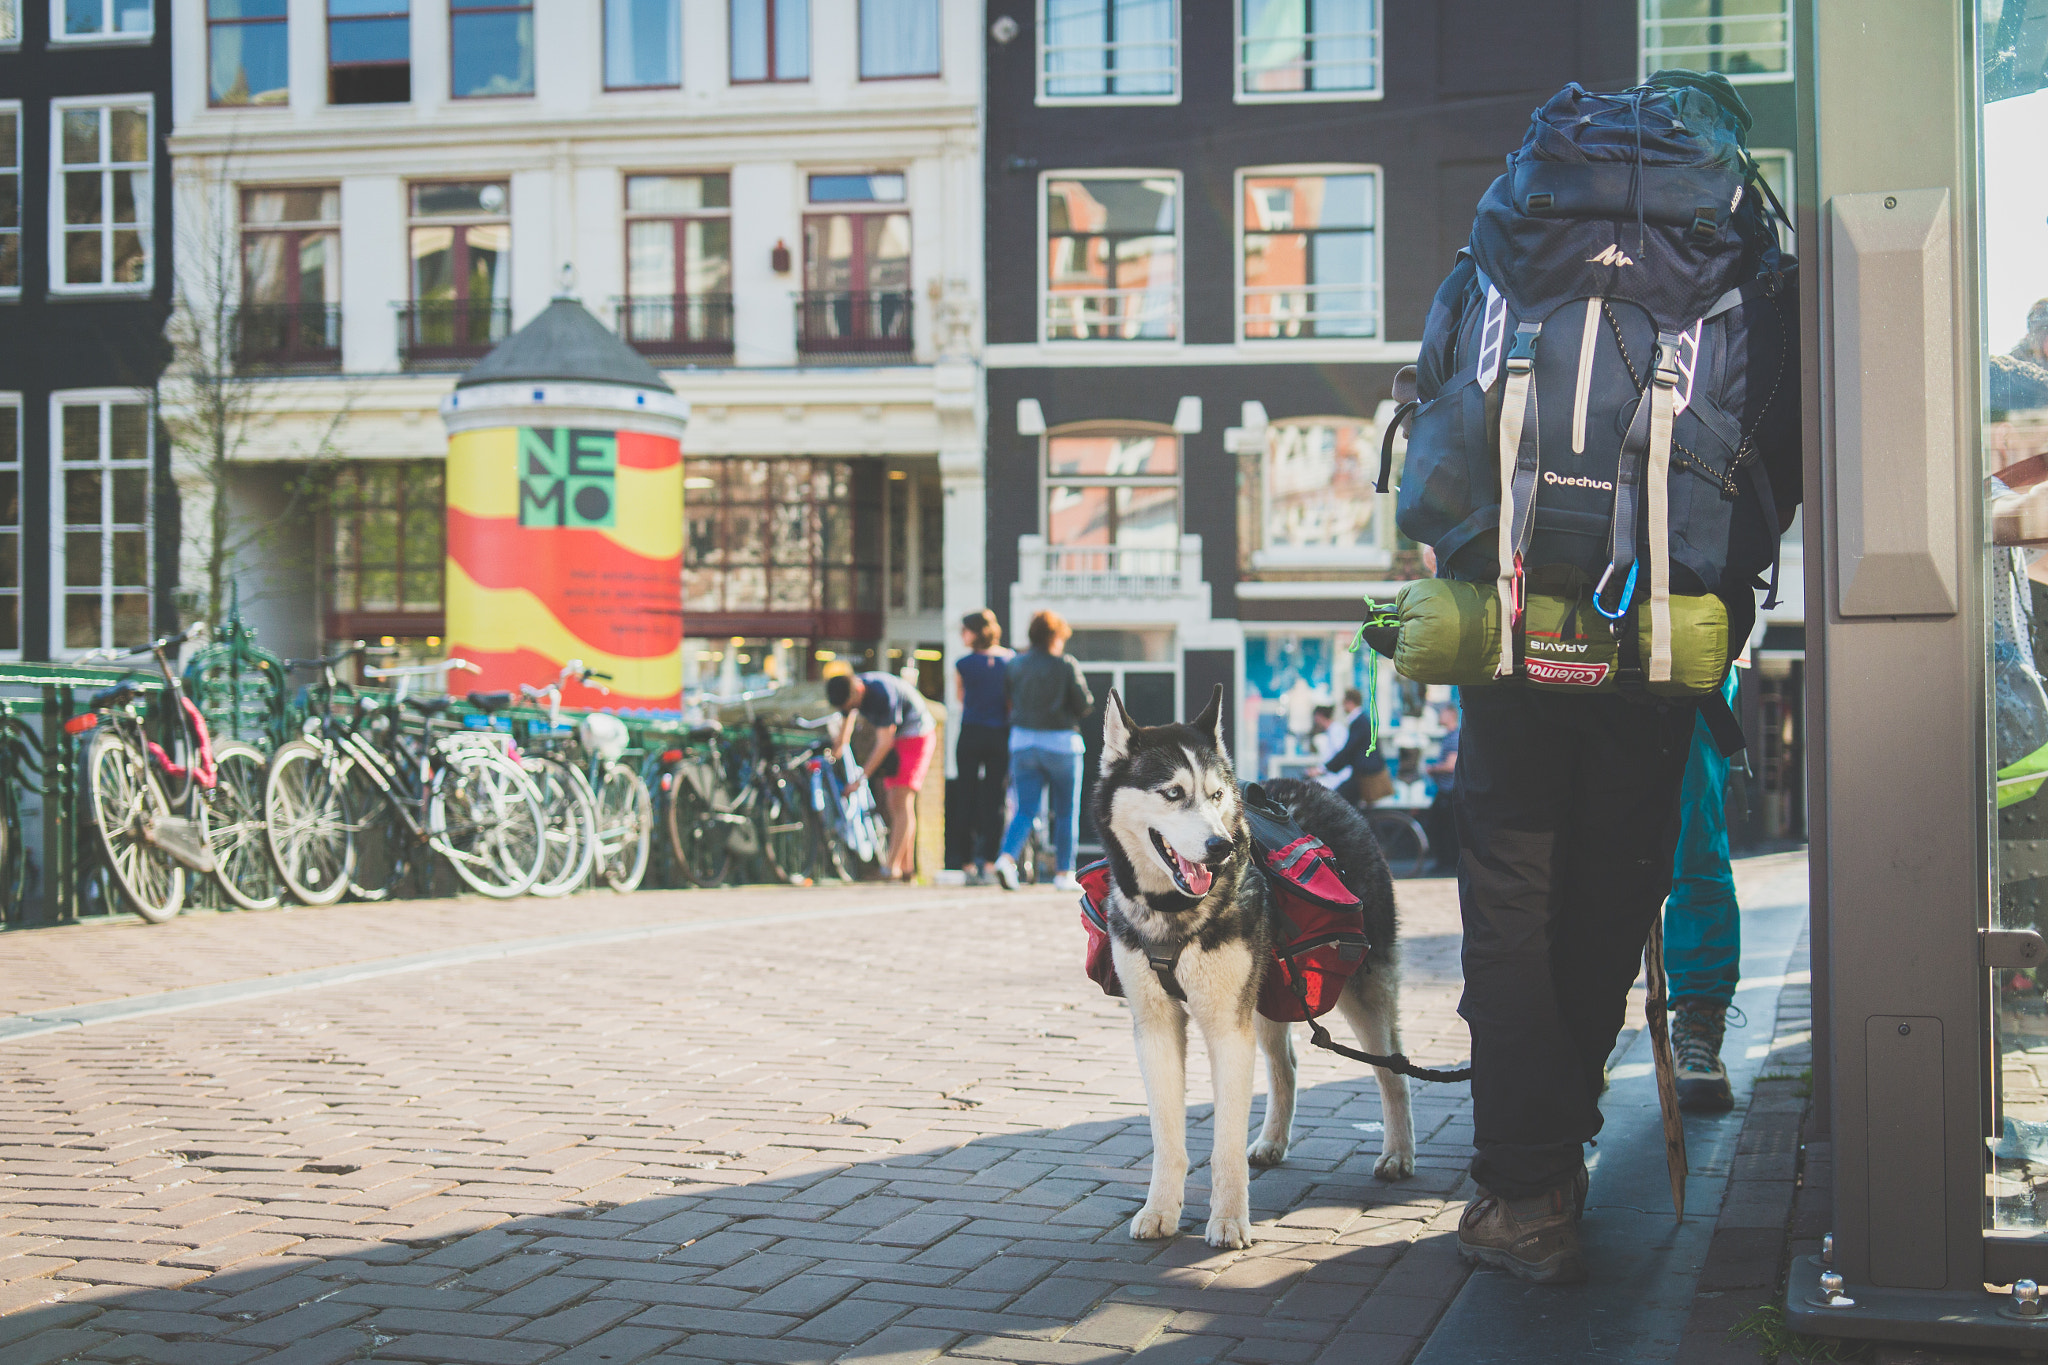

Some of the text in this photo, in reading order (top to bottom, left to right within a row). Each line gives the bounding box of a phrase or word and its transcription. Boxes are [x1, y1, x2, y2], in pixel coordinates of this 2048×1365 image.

[518, 426, 616, 476] NE
[1543, 471, 1613, 491] Quechua
[519, 479, 610, 527] MO
[1530, 640, 1589, 653] ARAVIS
